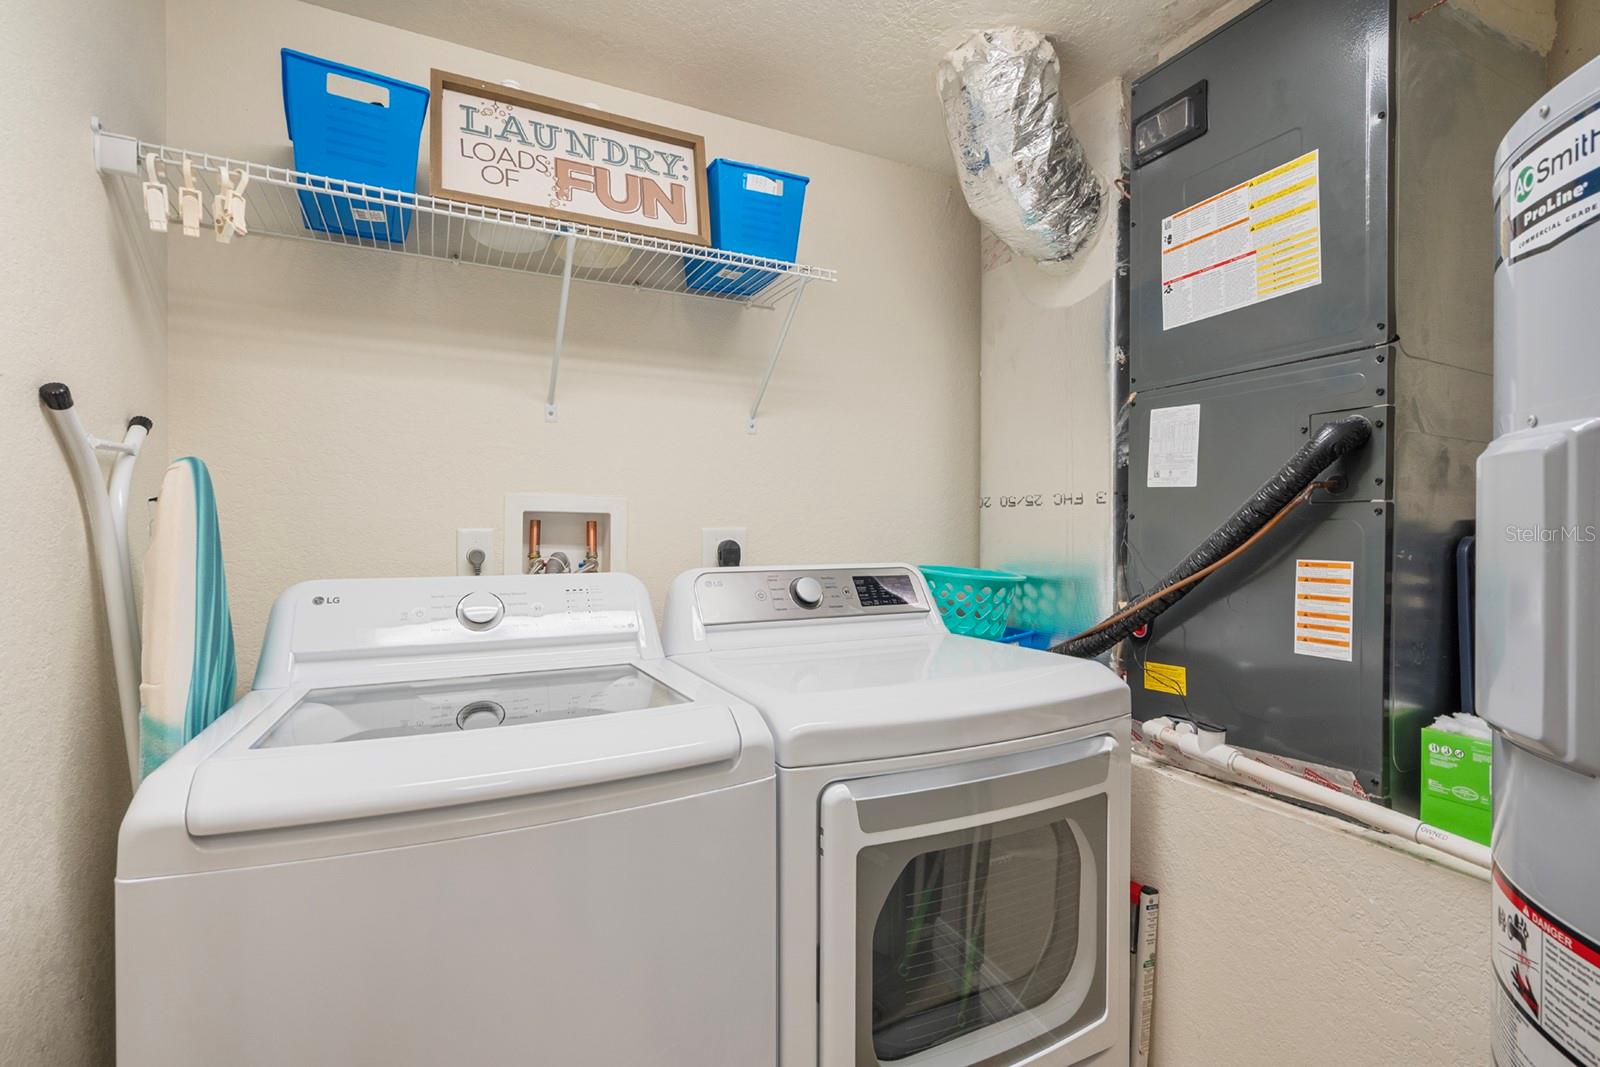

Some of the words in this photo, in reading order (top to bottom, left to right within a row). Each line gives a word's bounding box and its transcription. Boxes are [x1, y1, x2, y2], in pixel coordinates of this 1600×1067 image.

[460, 138, 549, 174] LOADS
[481, 165, 520, 187] OF
[554, 157, 688, 225] FUN
[1519, 221, 1561, 248] COMMERCIAL
[1565, 203, 1597, 222] GRADE
[1000, 494, 1043, 508] 25/50
[1053, 492, 1084, 506] FHC
[1531, 912, 1573, 949] DANGER
